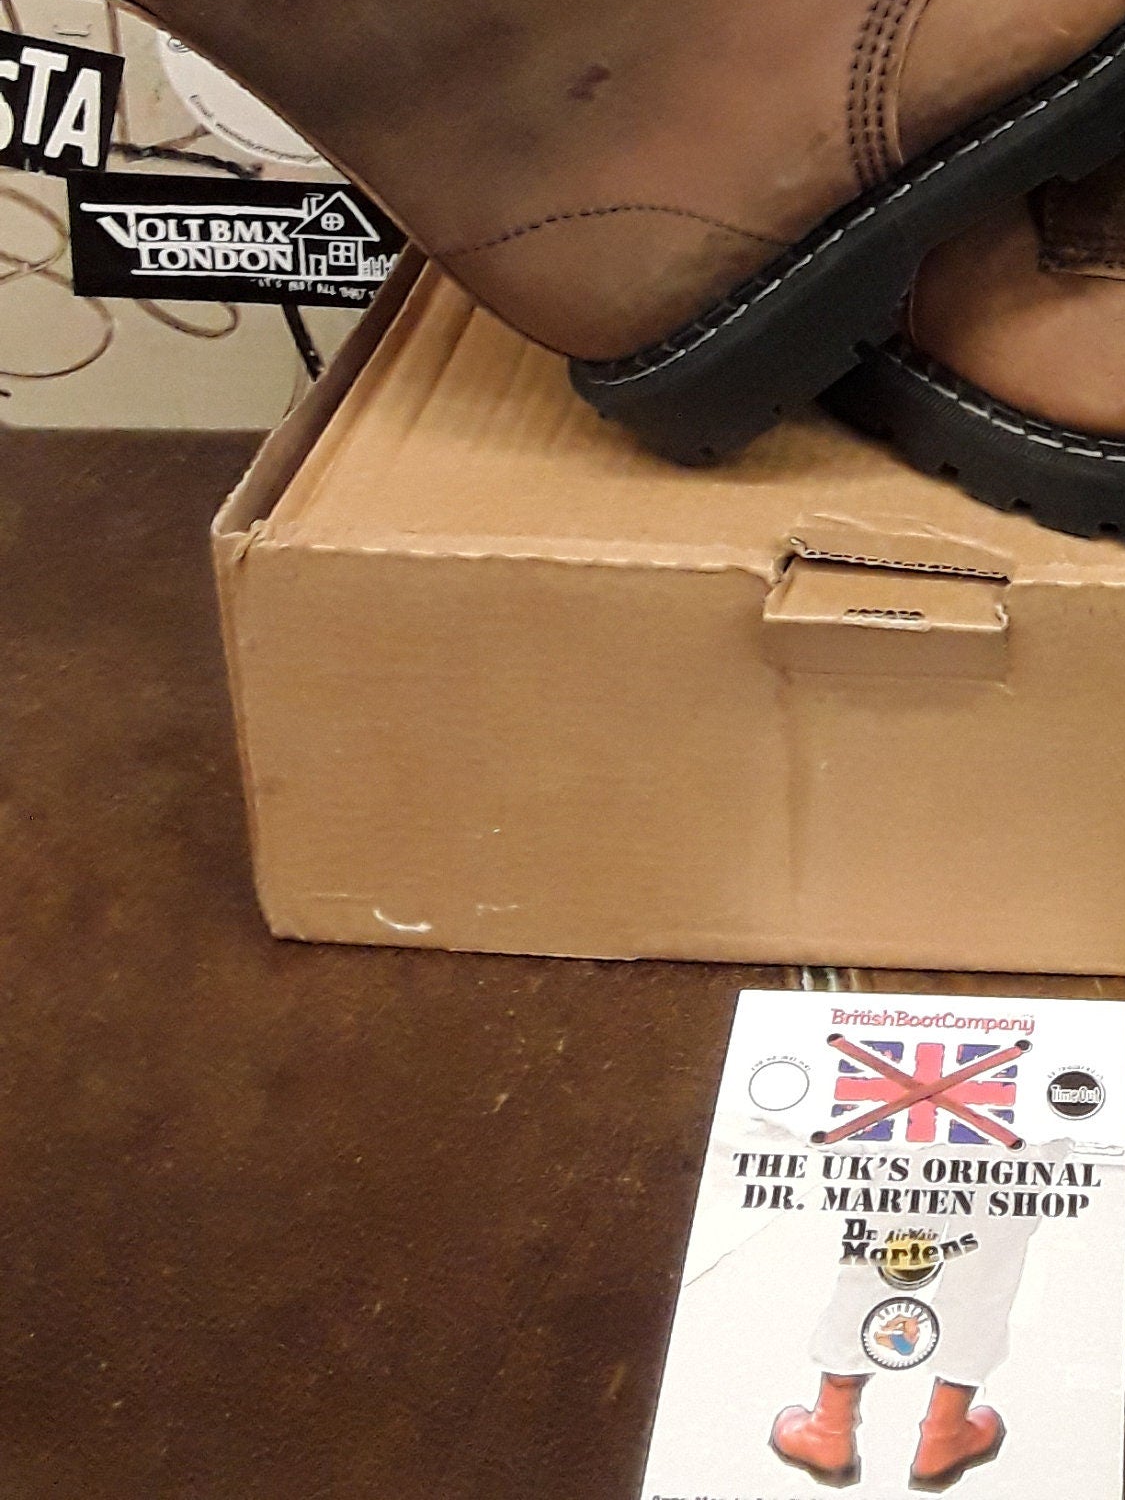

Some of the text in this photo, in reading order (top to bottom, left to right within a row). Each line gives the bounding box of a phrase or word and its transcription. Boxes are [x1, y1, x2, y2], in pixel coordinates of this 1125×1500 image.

[97, 209, 292, 248] VOLT BMX
[138, 244, 294, 272] LONDON
[733, 1153, 1101, 1187] THE UK'S ORIGINAL
[741, 1184, 1089, 1218] DR. MARTEN SHOP
[839, 1232, 979, 1266] Martens
